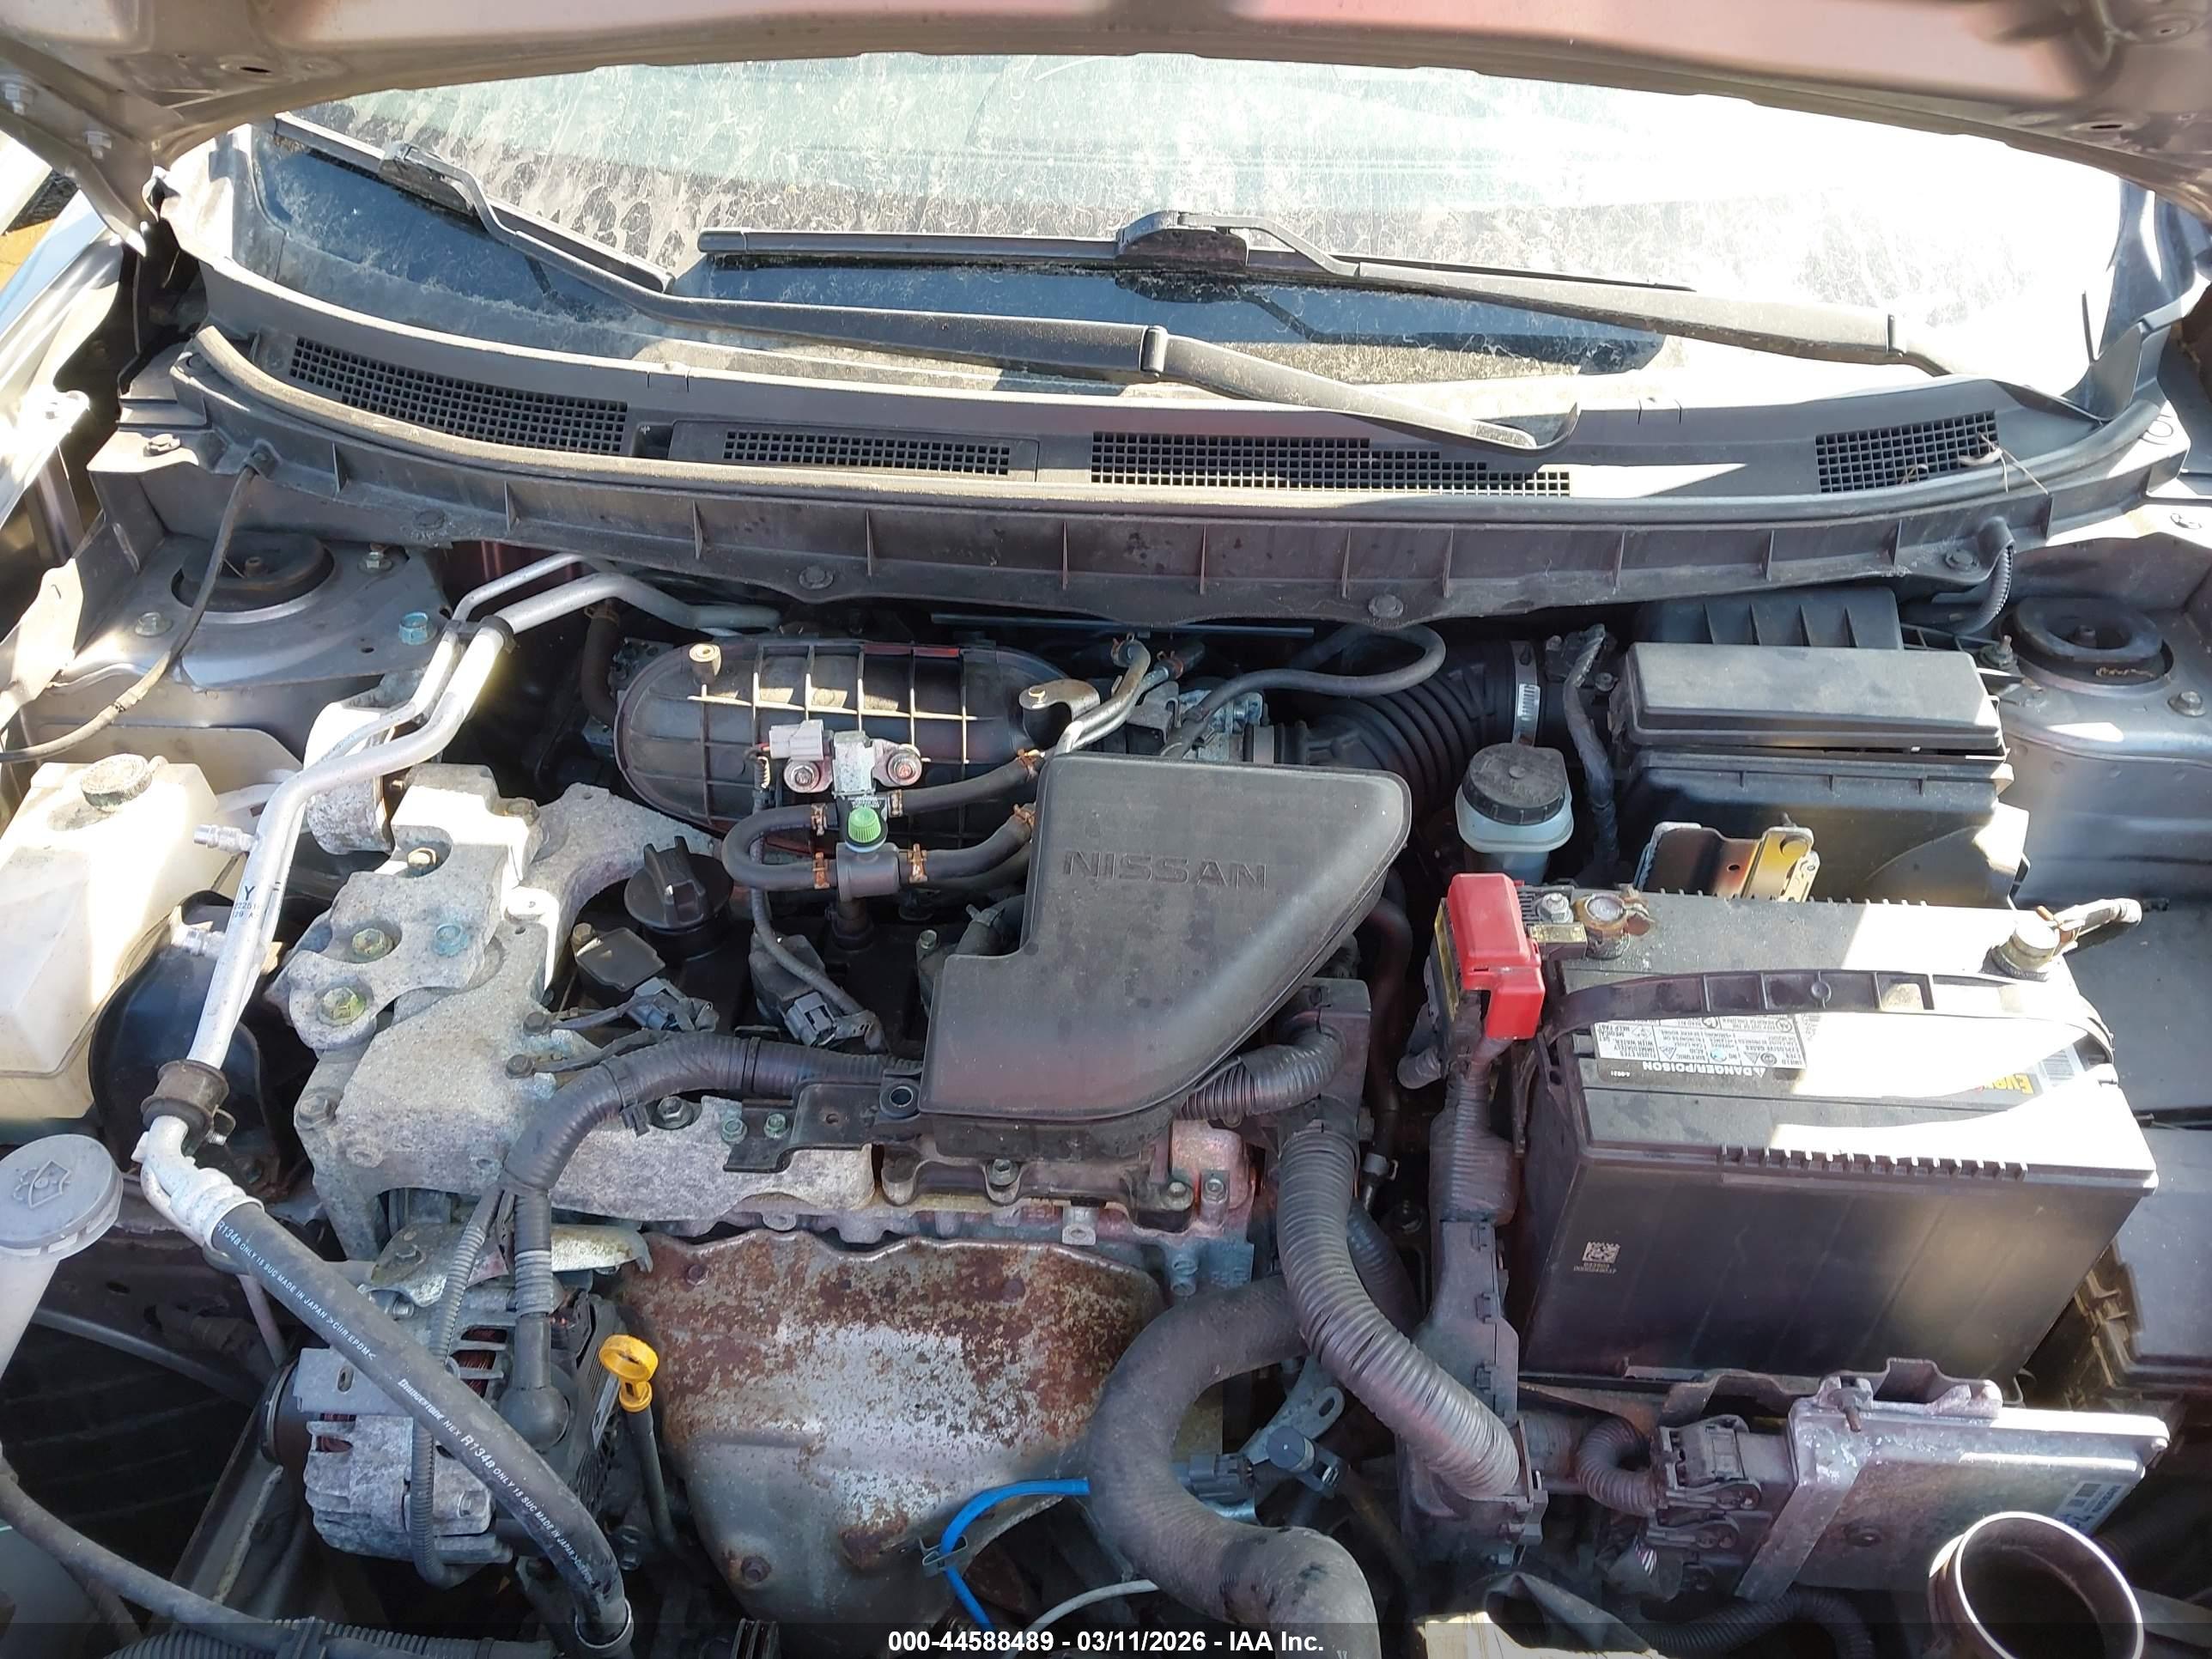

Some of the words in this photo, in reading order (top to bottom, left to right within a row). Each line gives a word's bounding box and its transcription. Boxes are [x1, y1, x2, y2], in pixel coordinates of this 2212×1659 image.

[1064, 850, 1268, 891] NISSAN
[245, 885, 256, 901] Y
[1642, 1060, 1753, 1077] DANGER/POISON
[240, 1243, 258, 1259] ONLY
[276, 1274, 297, 1292] MADE
[295, 1290, 306, 1300] IN
[303, 1298, 328, 1319] JAPAN
[443, 1419, 462, 1436] NEX
[460, 1435, 495, 1468] R134a
[493, 1467, 515, 1487] ONLY
[513, 1487, 524, 1498] 15
[520, 1496, 538, 1511] SUC
[534, 1510, 555, 1530] MADE
[550, 1529, 561, 1538] IN
[556, 1537, 575, 1559] JAPAN
